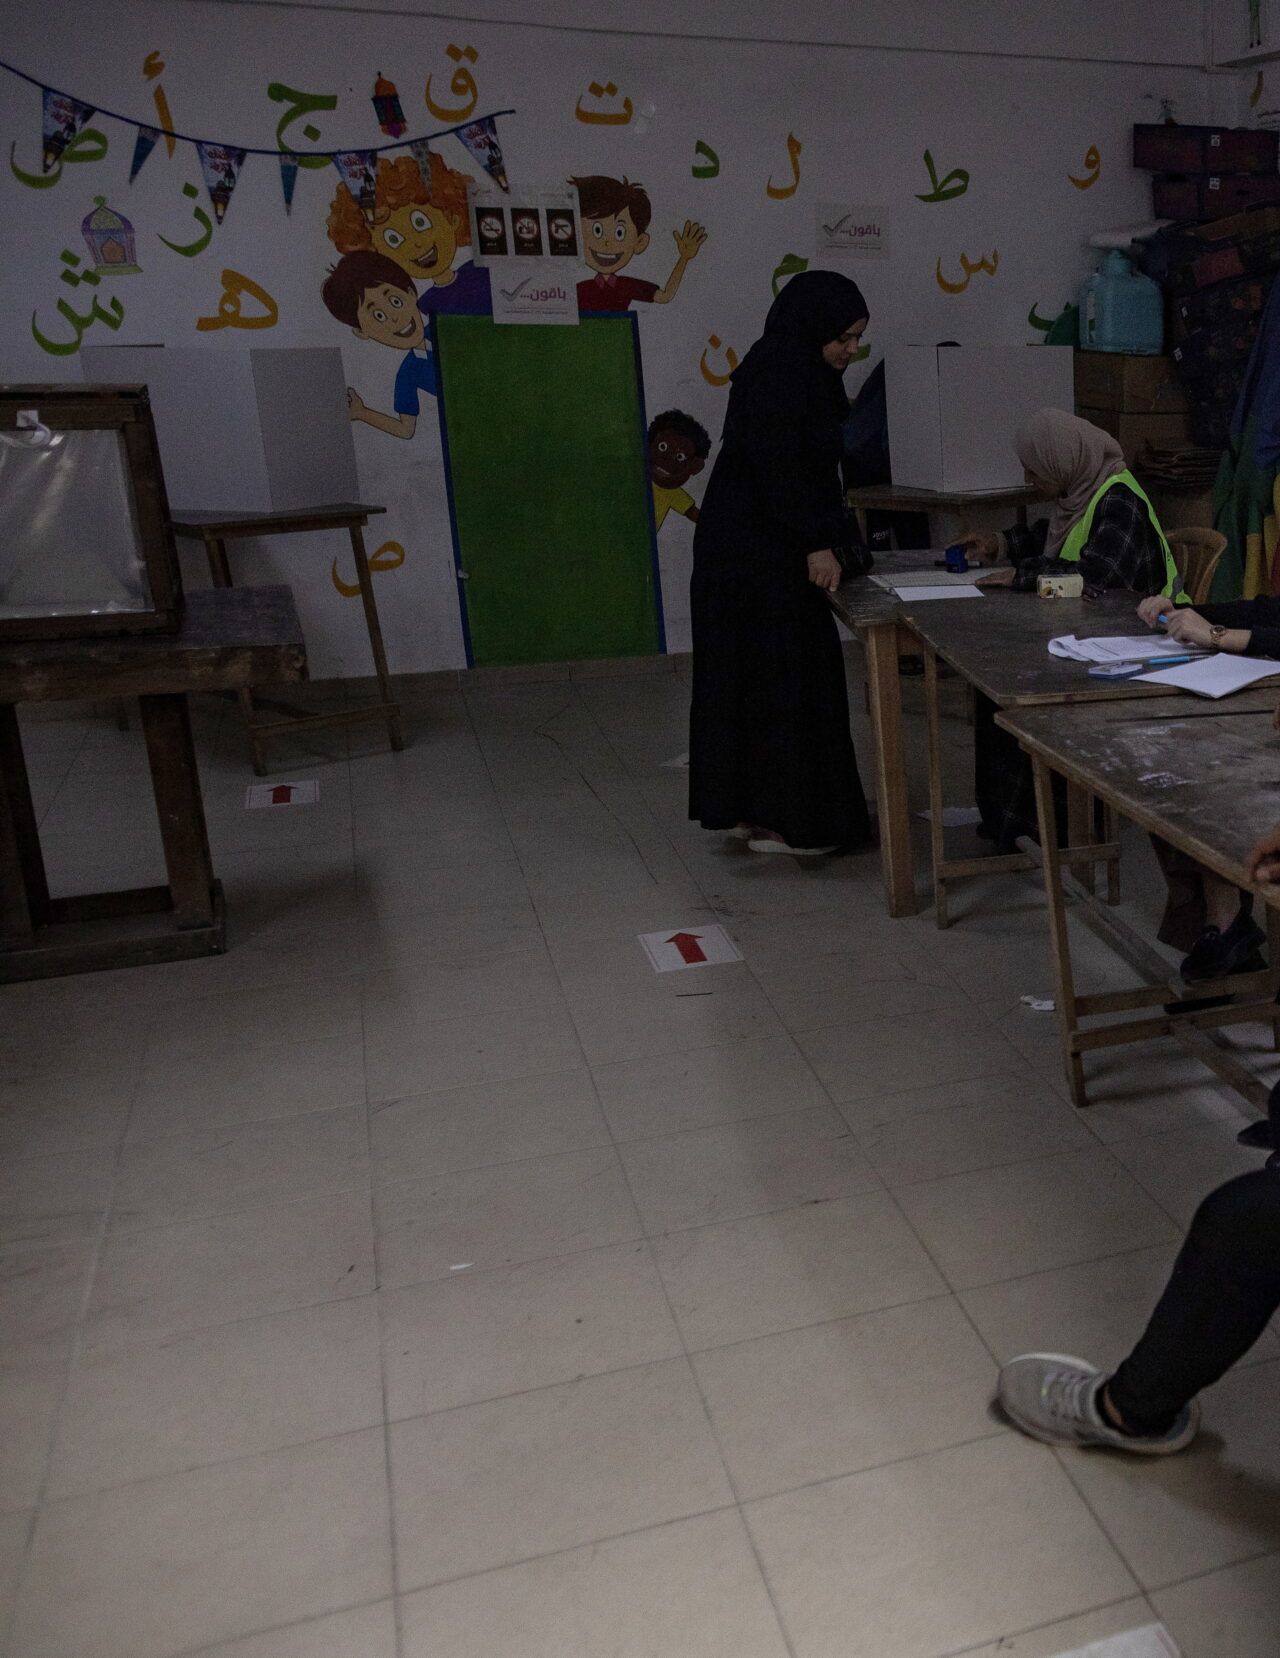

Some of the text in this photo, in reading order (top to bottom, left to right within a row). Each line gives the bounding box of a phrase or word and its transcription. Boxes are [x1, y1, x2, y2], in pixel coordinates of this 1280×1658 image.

[267, 82, 338, 169] ج
[575, 81, 633, 125] ت
[691, 140, 720, 179] د
[914, 149, 970, 203] ط
[1067, 145, 1101, 190] و
[936, 248, 999, 294] س
[32, 249, 125, 356] ش
